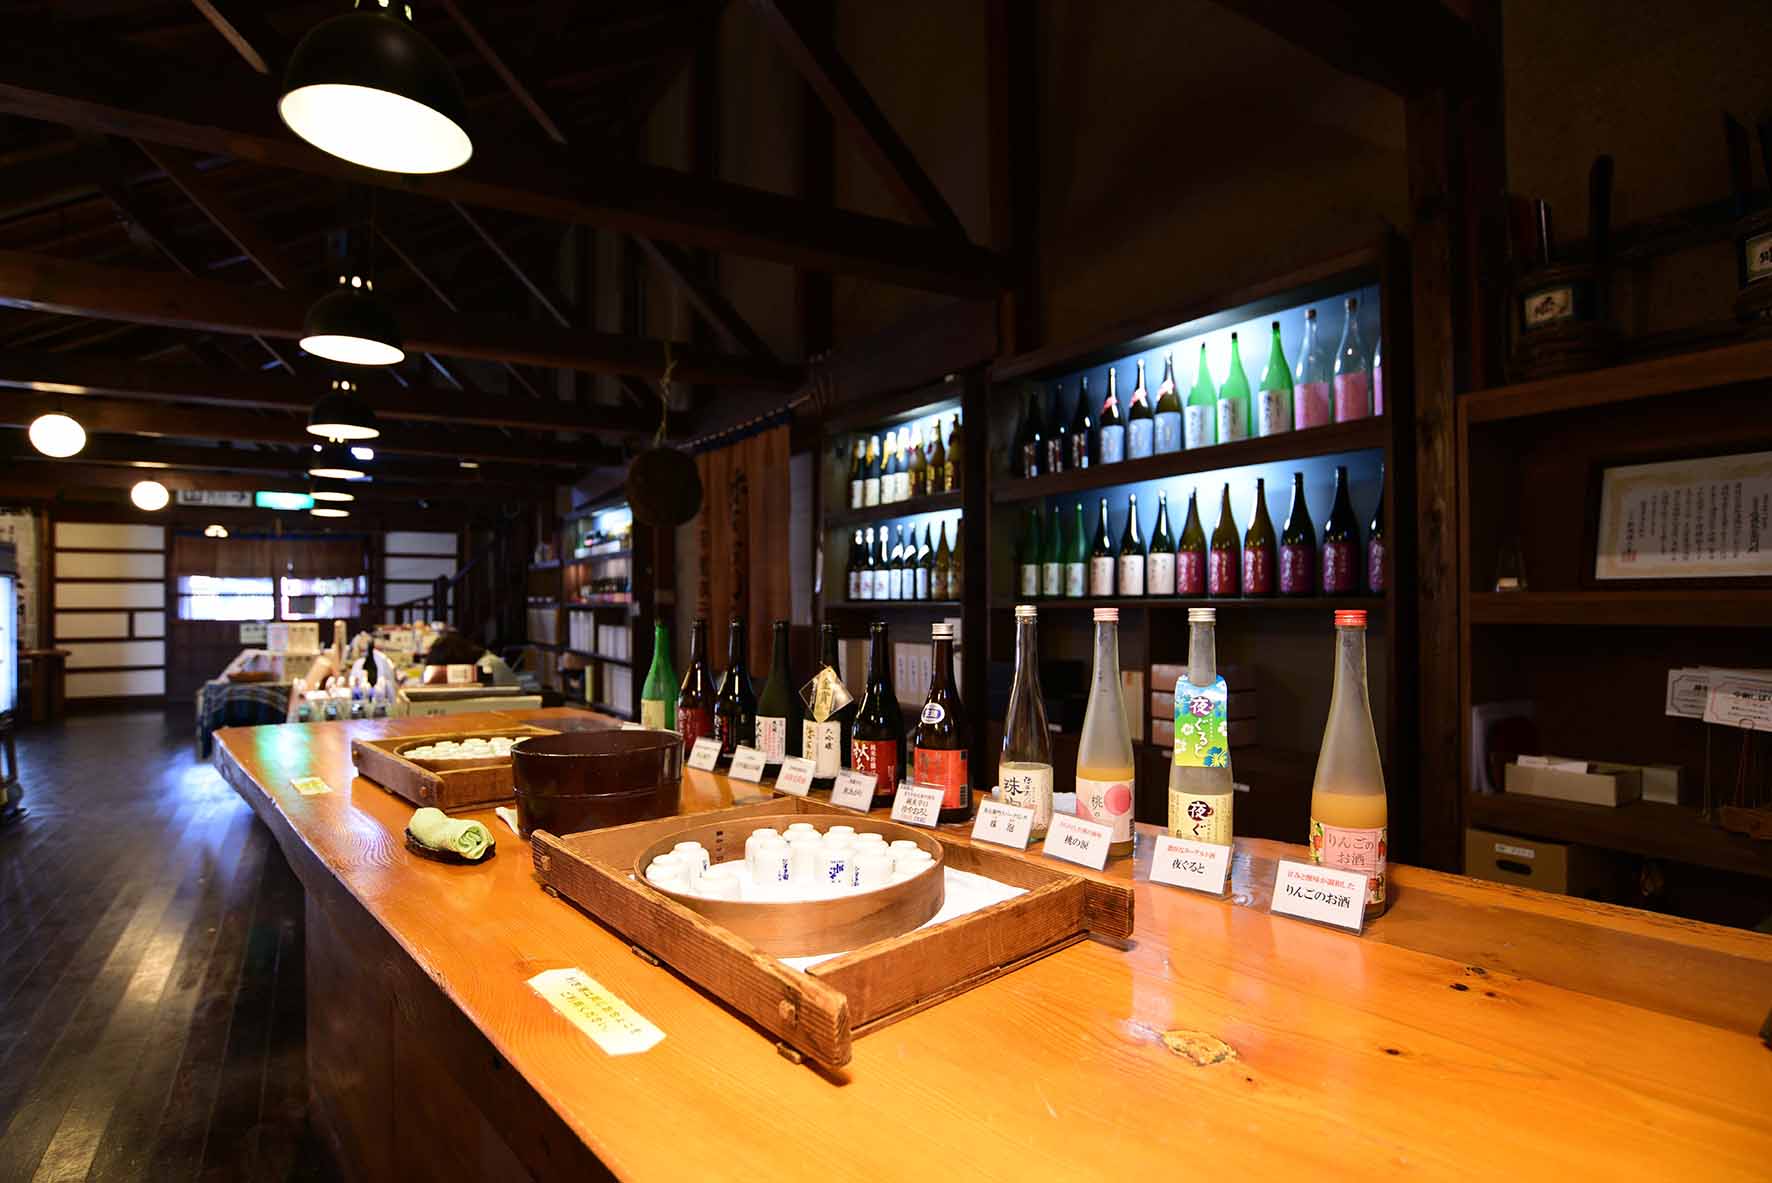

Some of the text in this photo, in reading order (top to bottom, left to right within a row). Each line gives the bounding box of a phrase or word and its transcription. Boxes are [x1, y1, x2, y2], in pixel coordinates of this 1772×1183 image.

[1328, 833, 1375, 850] りんごの
[1337, 851, 1365, 866] お酒
[1286, 883, 1352, 909] りんごのお酒
